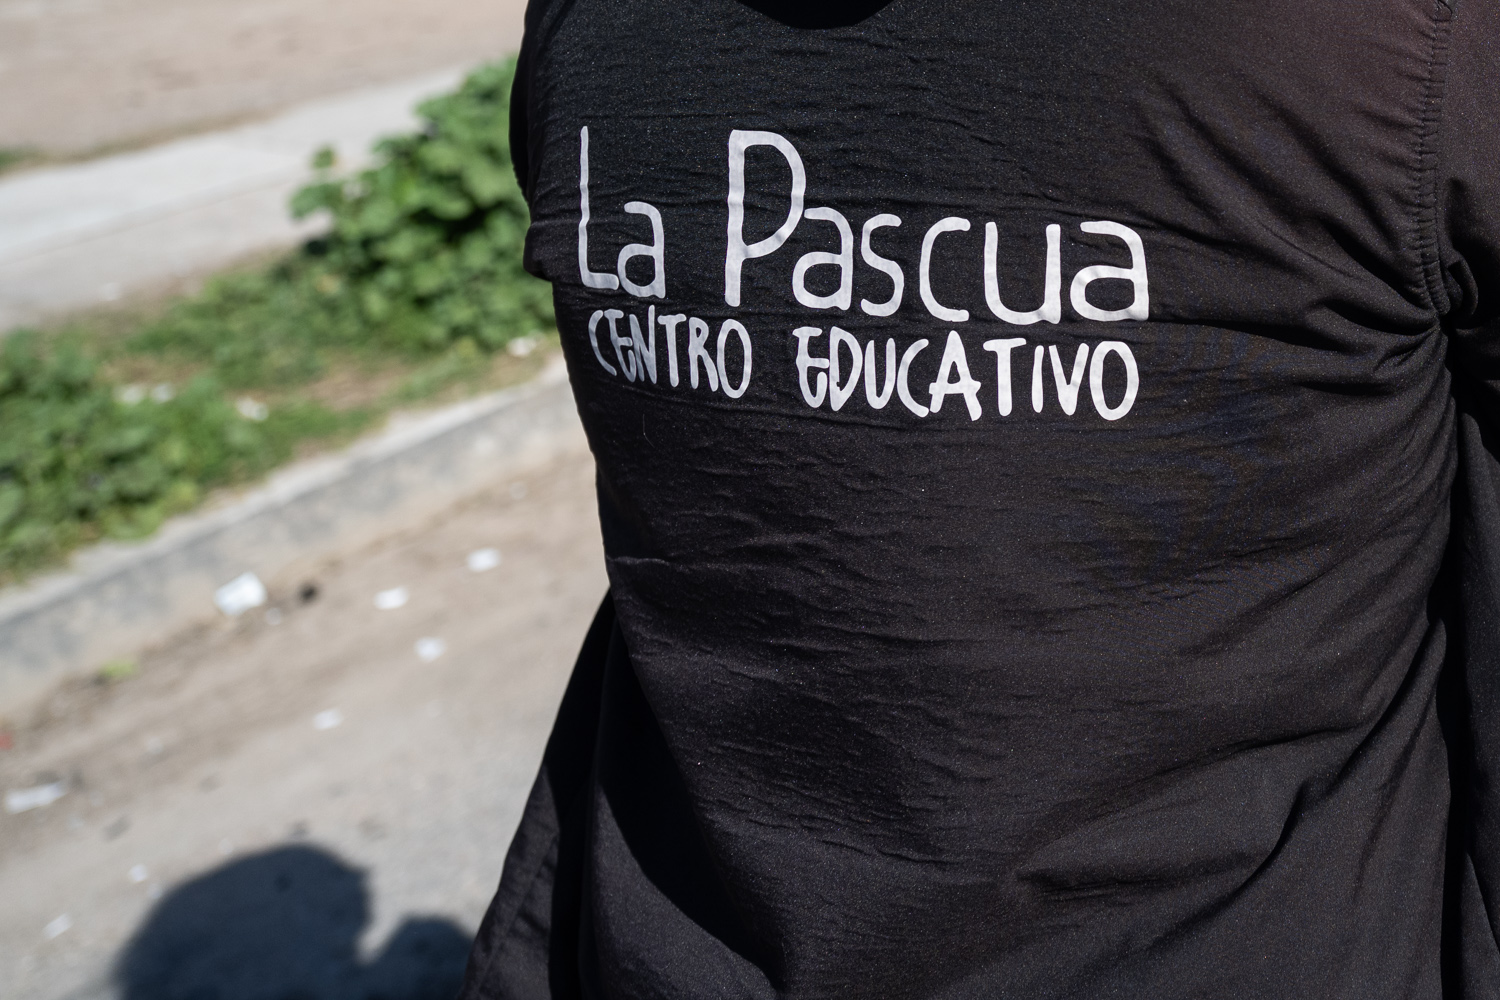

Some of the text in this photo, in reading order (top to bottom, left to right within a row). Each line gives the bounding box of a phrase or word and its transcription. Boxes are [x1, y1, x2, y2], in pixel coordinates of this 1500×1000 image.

[577, 125, 1150, 326] La Pascua
[588, 304, 1140, 422] CENTRO EDUCATIVO
